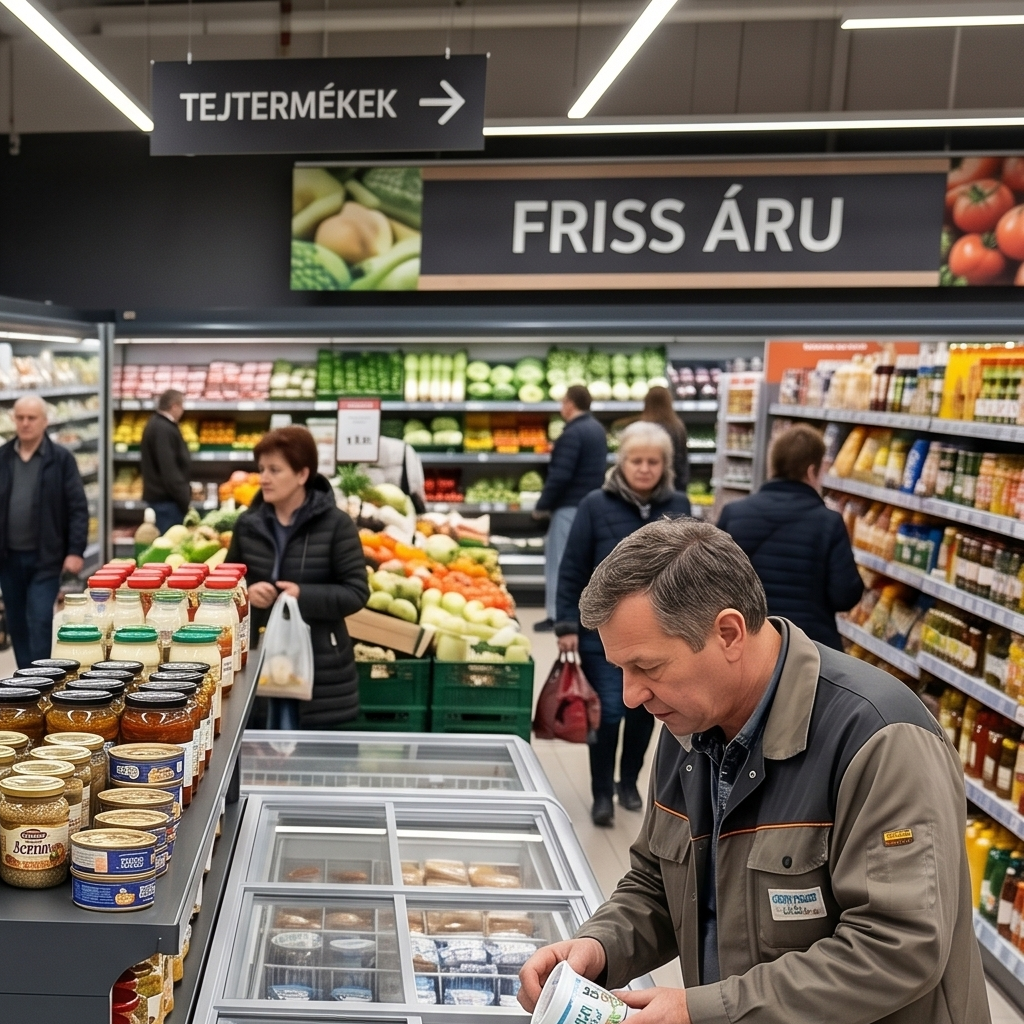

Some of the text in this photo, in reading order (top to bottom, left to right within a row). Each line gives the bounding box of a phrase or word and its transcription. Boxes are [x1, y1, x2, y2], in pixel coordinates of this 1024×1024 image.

[179, 82, 398, 122] TEJTERMÉKEK
[512, 184, 845, 255] FRISS ÁRU
